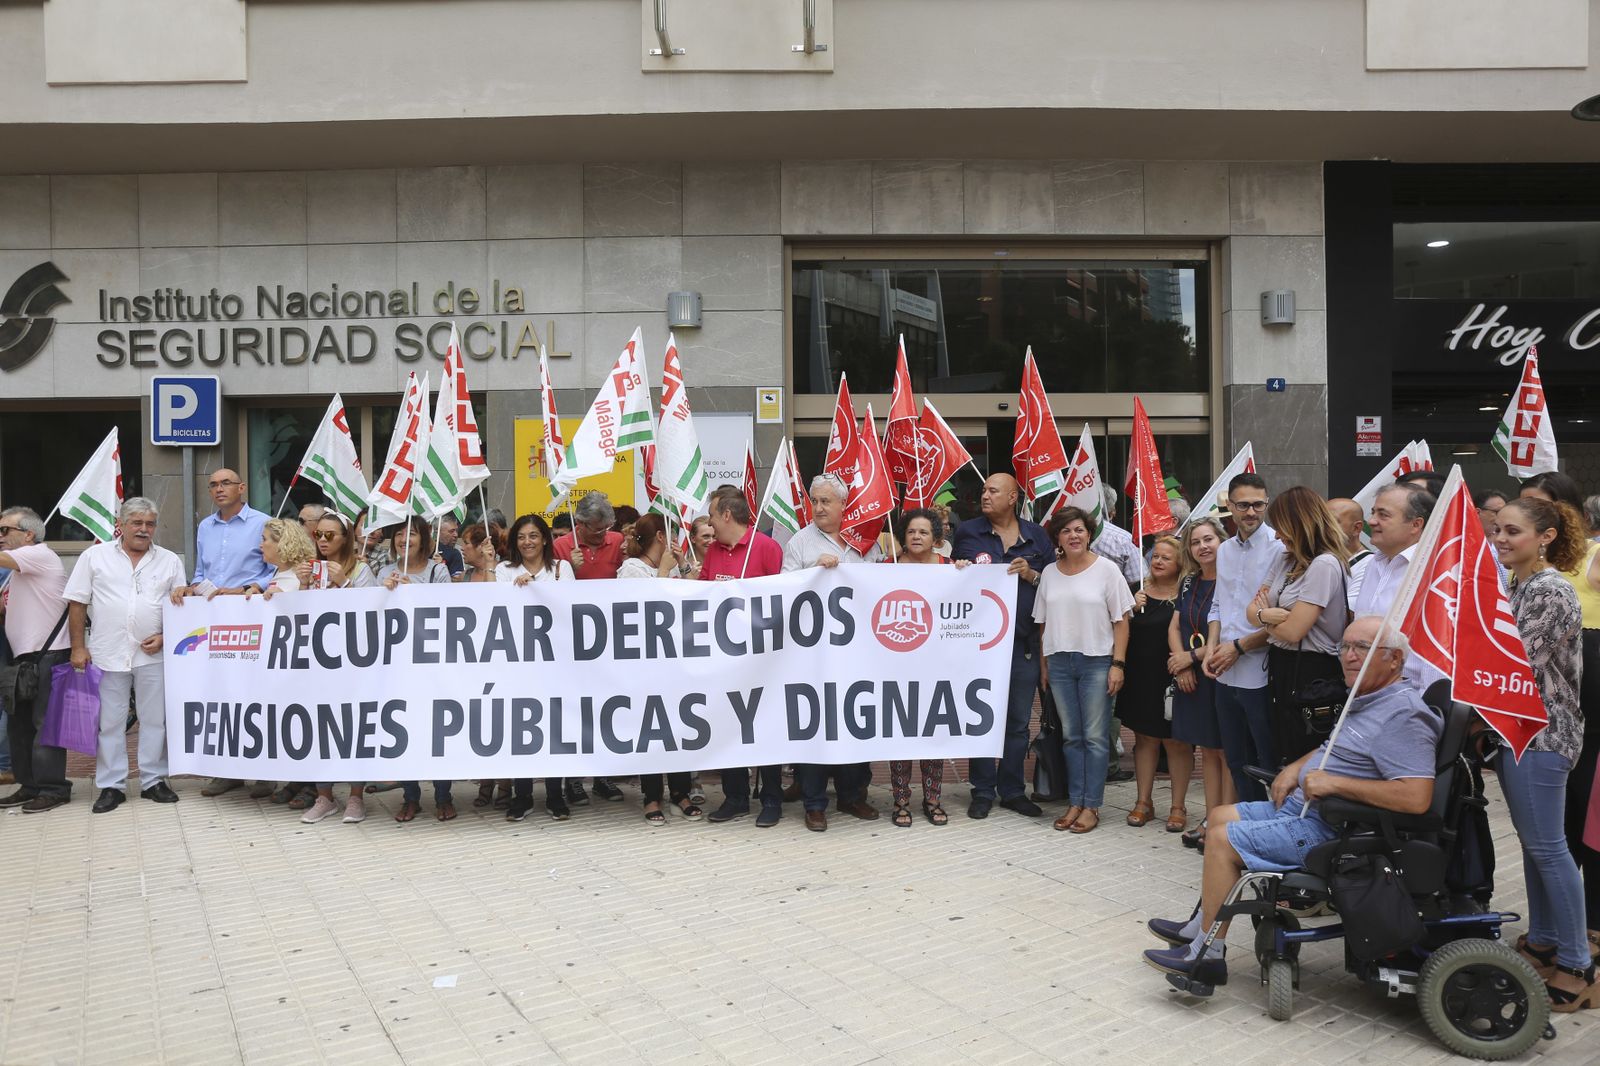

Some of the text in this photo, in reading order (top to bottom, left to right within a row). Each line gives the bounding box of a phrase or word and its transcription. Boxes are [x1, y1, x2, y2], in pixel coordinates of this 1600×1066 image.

[99, 279, 525, 322] Instituto Nacional de la
[97, 319, 572, 369] SEGURIDAD SOCIAL
[1449, 303, 1546, 367] Hoy
[1273, 379, 1280, 390] 4
[159, 384, 198, 436] P
[172, 429, 211, 437] BICICLETAS
[594, 399, 618, 459] Málaga
[267, 586, 856, 670] RECUPERAR DERECHOS
[879, 600, 926, 624] UGT
[940, 602, 973, 619] UJP
[945, 631, 985, 639] Pensionistas
[184, 678, 995, 760] PENSIONES PÚBLICAS Y DIGNAS
